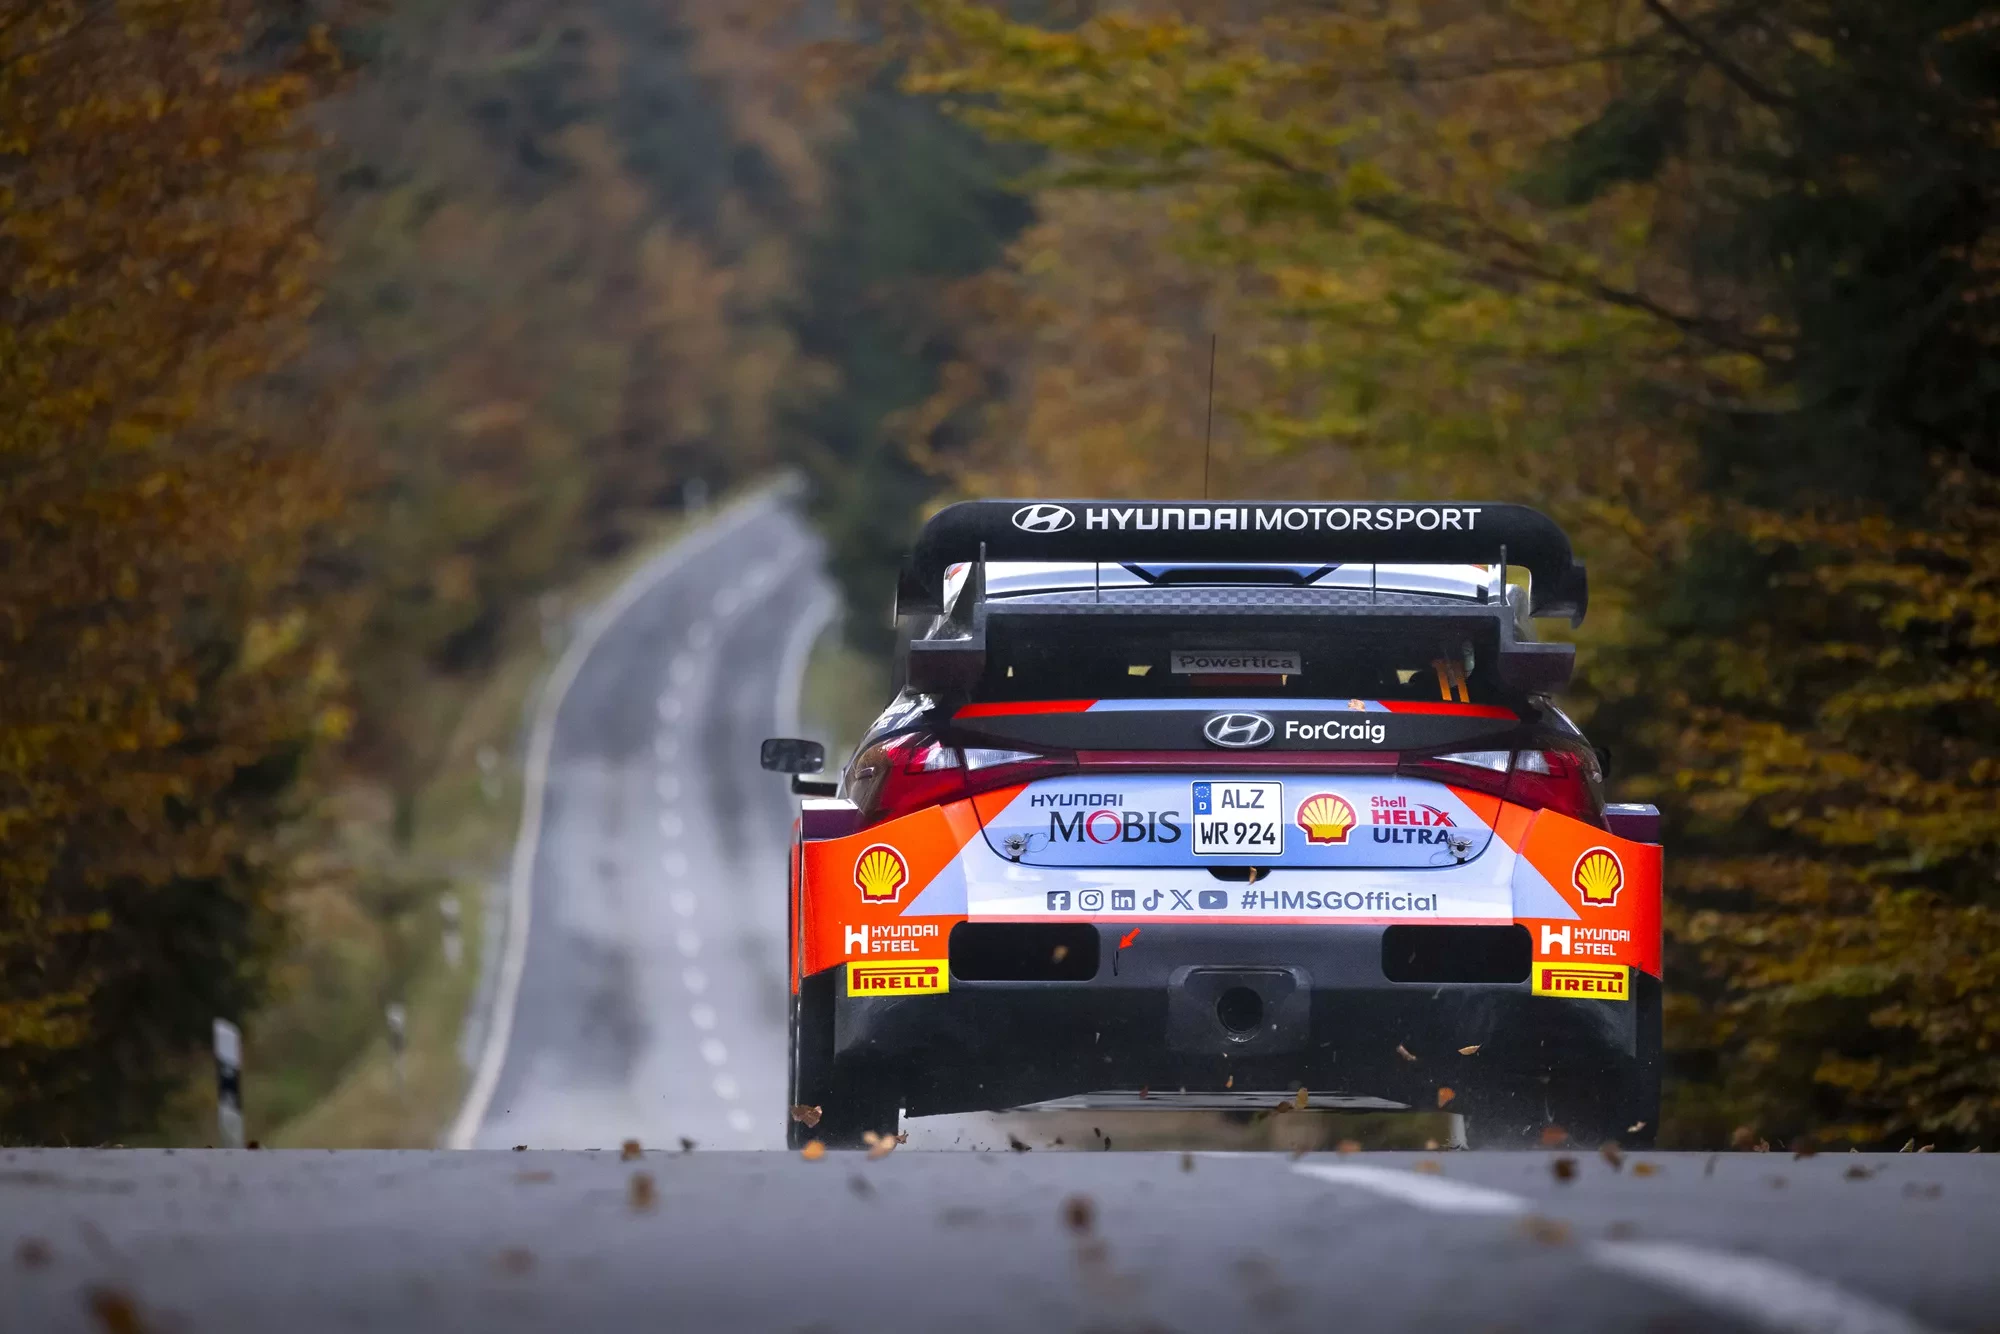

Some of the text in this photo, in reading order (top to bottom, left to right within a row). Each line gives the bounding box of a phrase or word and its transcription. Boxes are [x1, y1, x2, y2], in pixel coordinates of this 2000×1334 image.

[1086, 507, 1481, 531] HYUNDAI MOTORSPORT
[1178, 655, 1294, 669] Powertica
[1285, 720, 1386, 743] ForCraig
[1031, 794, 1123, 807] HYUNDAI
[1199, 802, 1207, 811] D
[1221, 789, 1265, 809] ALZ
[1371, 796, 1406, 808] Shell
[1049, 809, 1182, 845] MOBIS
[1371, 808, 1455, 828] HELIX
[1200, 822, 1276, 845] WR 924
[1373, 827, 1450, 845] ULTRA
[1240, 890, 1438, 912] #HMSGOfficial
[872, 925, 938, 936] HYUNDAI
[1574, 928, 1630, 942] HYUNDAI
[871, 940, 920, 952] STEEL
[1574, 943, 1616, 956] STEEL
[853, 966, 939, 990] PIRELLI
[1541, 969, 1624, 994] PIRELLI
